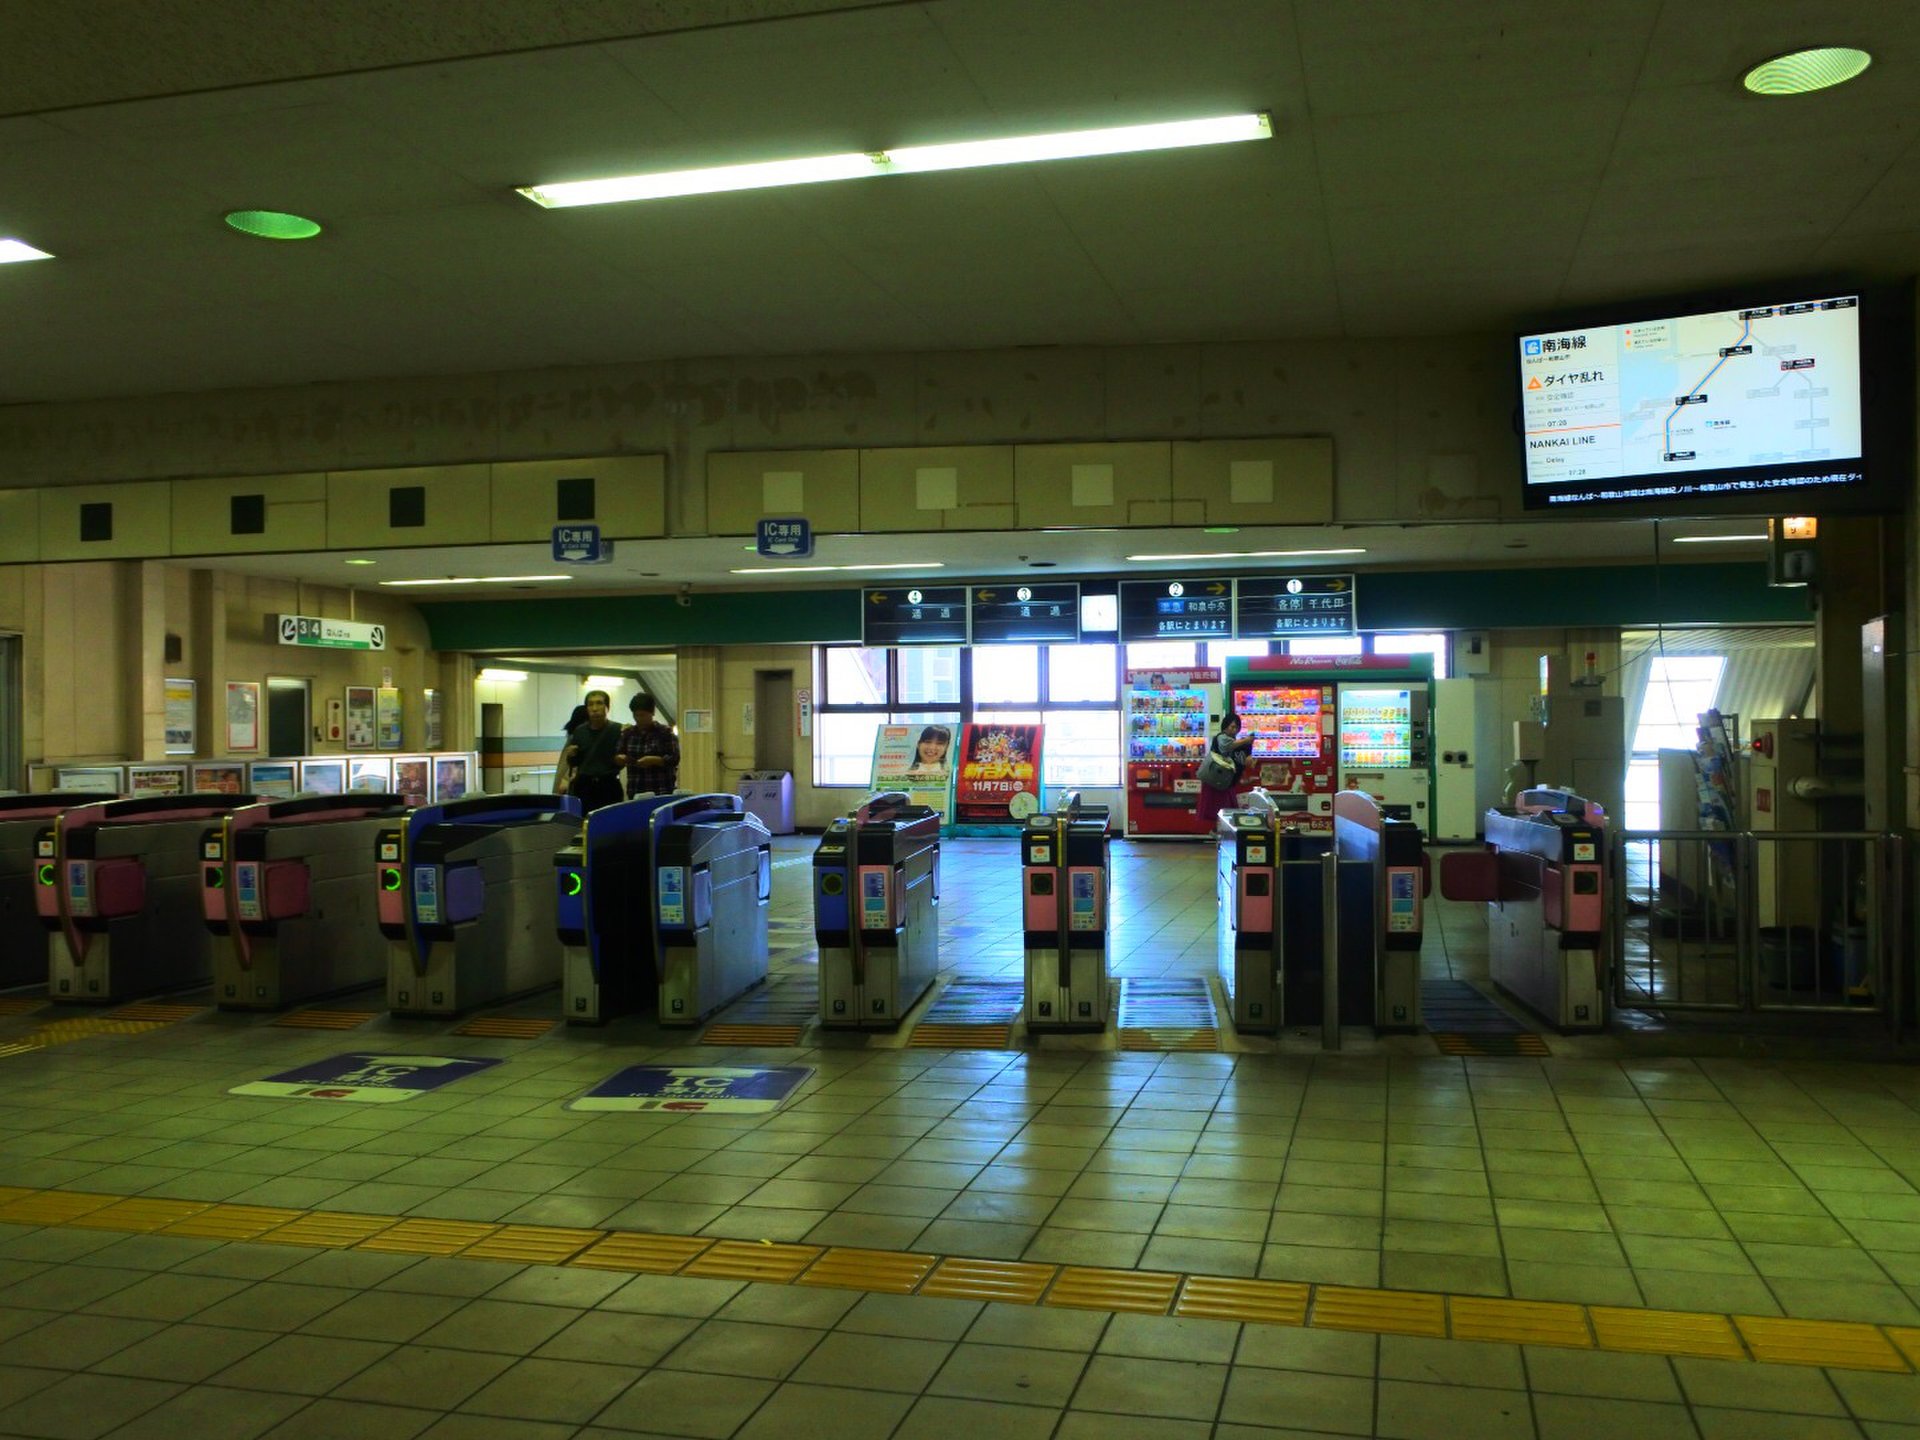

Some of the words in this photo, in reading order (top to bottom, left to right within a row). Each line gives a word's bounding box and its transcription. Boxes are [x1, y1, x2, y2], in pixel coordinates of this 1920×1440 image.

[1542, 335, 1587, 353] 南海線
[1544, 371, 1604, 387] ダイヤ乱れ
[1529, 438, 1569, 449] NANKAI
[1572, 435, 1596, 446] LINE
[558, 528, 593, 543] IC専用
[764, 521, 801, 537] IC専用
[1188, 601, 1226, 612] 和泉中央
[1309, 597, 1345, 609] 千代田
[299, 621, 308, 635] 3
[311, 622, 320, 636] 4
[1159, 620, 1226, 631] 各駅にとまります
[1276, 617, 1346, 629] 各駅にとまります
[352, 1065, 419, 1076] IC
[668, 1076, 734, 1087] IC
